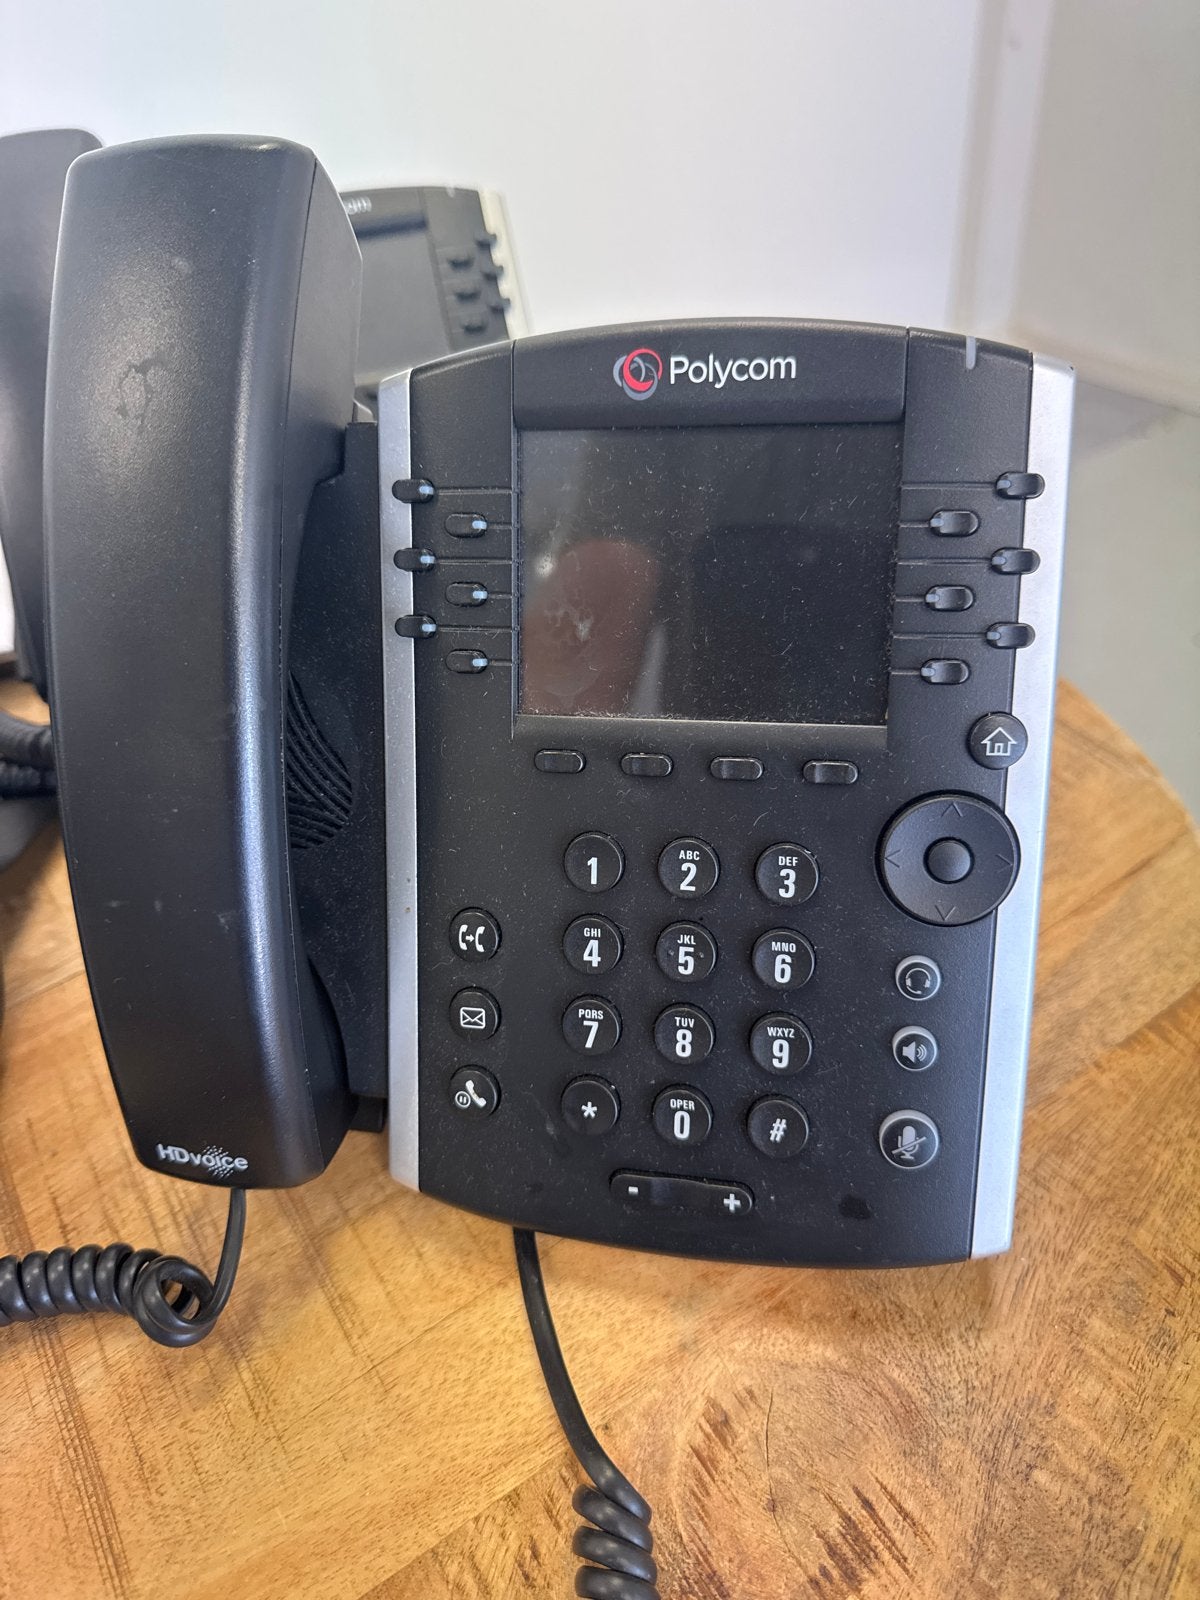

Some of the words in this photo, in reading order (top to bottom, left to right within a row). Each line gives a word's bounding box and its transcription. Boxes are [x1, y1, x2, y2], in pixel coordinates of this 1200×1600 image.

[669, 353, 797, 389] Polycom
[679, 850, 700, 861] ABC
[778, 856, 799, 866] DEF
[587, 857, 598, 885] 1
[680, 863, 697, 891] 2
[778, 869, 796, 898] 3
[583, 927, 601, 938] GHI
[677, 934, 696, 945] JKL
[583, 940, 601, 967] 4
[678, 947, 694, 975] 5
[771, 942, 796, 953] MNO
[774, 954, 792, 983] 6
[583, 1021, 599, 1048] 7
[674, 1016, 695, 1028] TUV
[767, 1027, 795, 1039] WXYZ
[675, 1029, 692, 1058] 8
[772, 1039, 789, 1069] 9
[669, 1098, 695, 1111] OPER
[673, 1111, 691, 1139] 0
